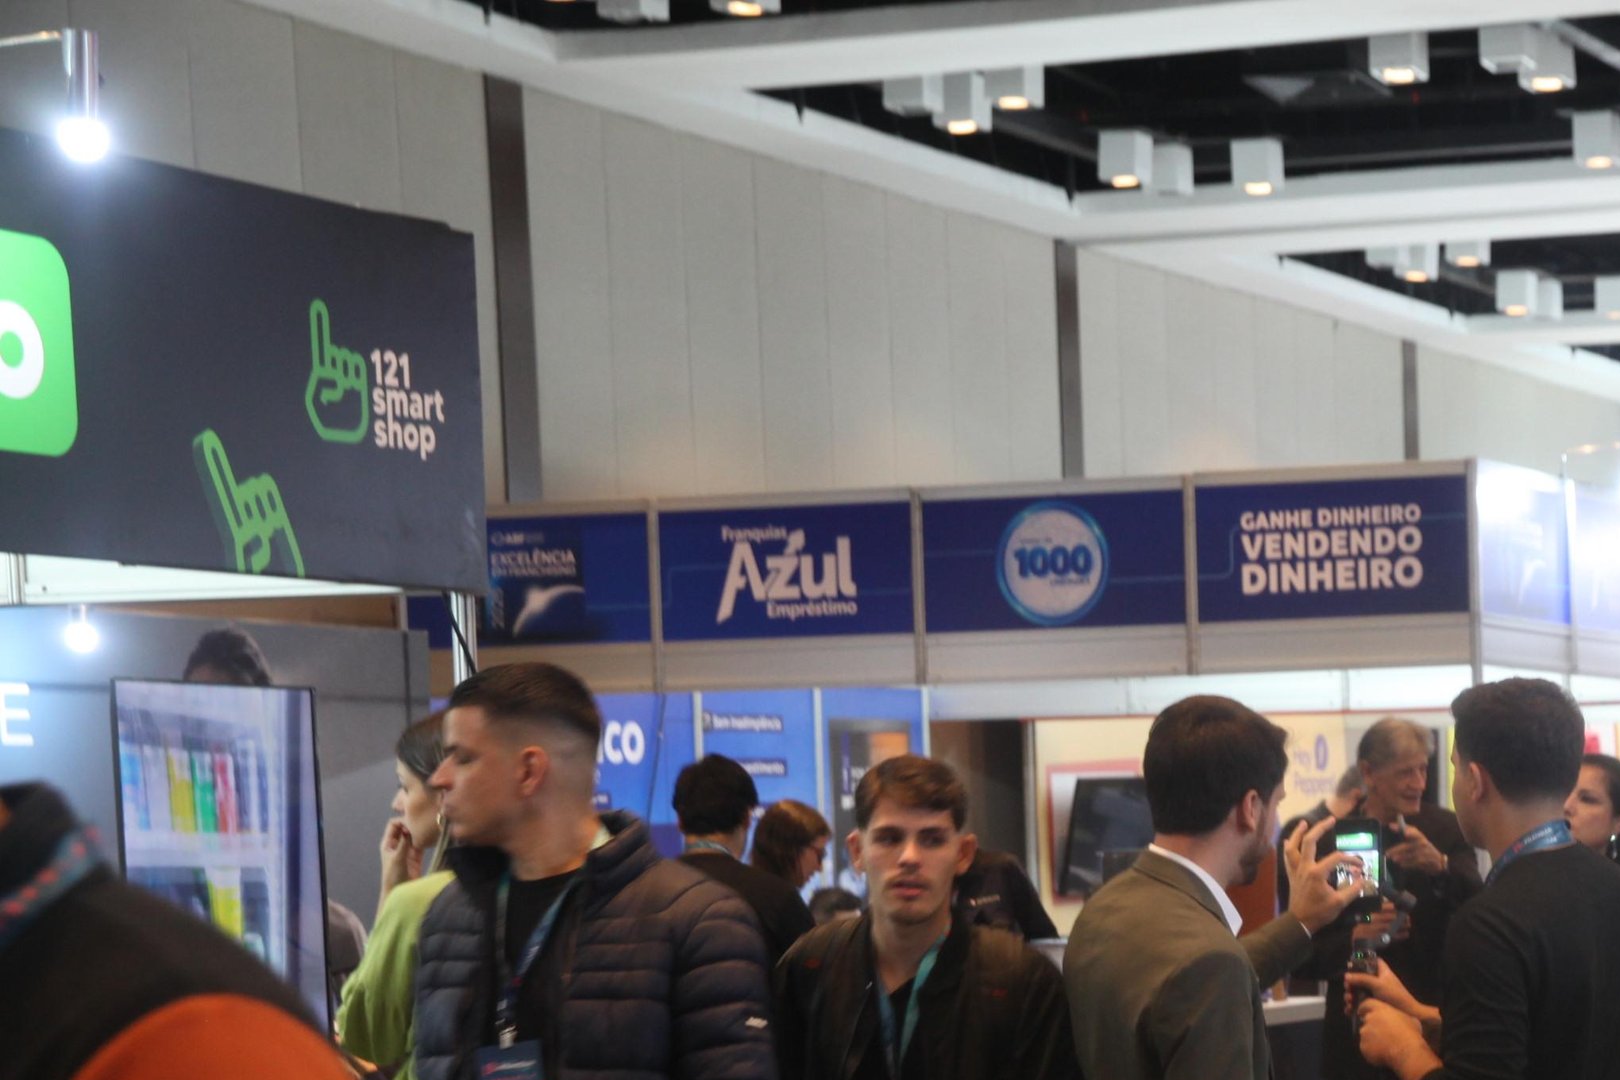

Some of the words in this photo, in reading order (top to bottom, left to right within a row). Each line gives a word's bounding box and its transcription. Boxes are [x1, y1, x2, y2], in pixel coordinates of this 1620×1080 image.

[370, 348, 410, 390] 121
[372, 387, 445, 424] smart
[374, 418, 437, 461] shop
[722, 524, 788, 543] Franquias
[1240, 510, 1313, 532] GANHE
[1317, 503, 1422, 527] DINHEIRO
[1013, 543, 1092, 578] 1000
[1240, 525, 1423, 561] VENDENDO
[1241, 555, 1424, 596] DINHEIRO
[767, 600, 858, 621] Empréstimo
